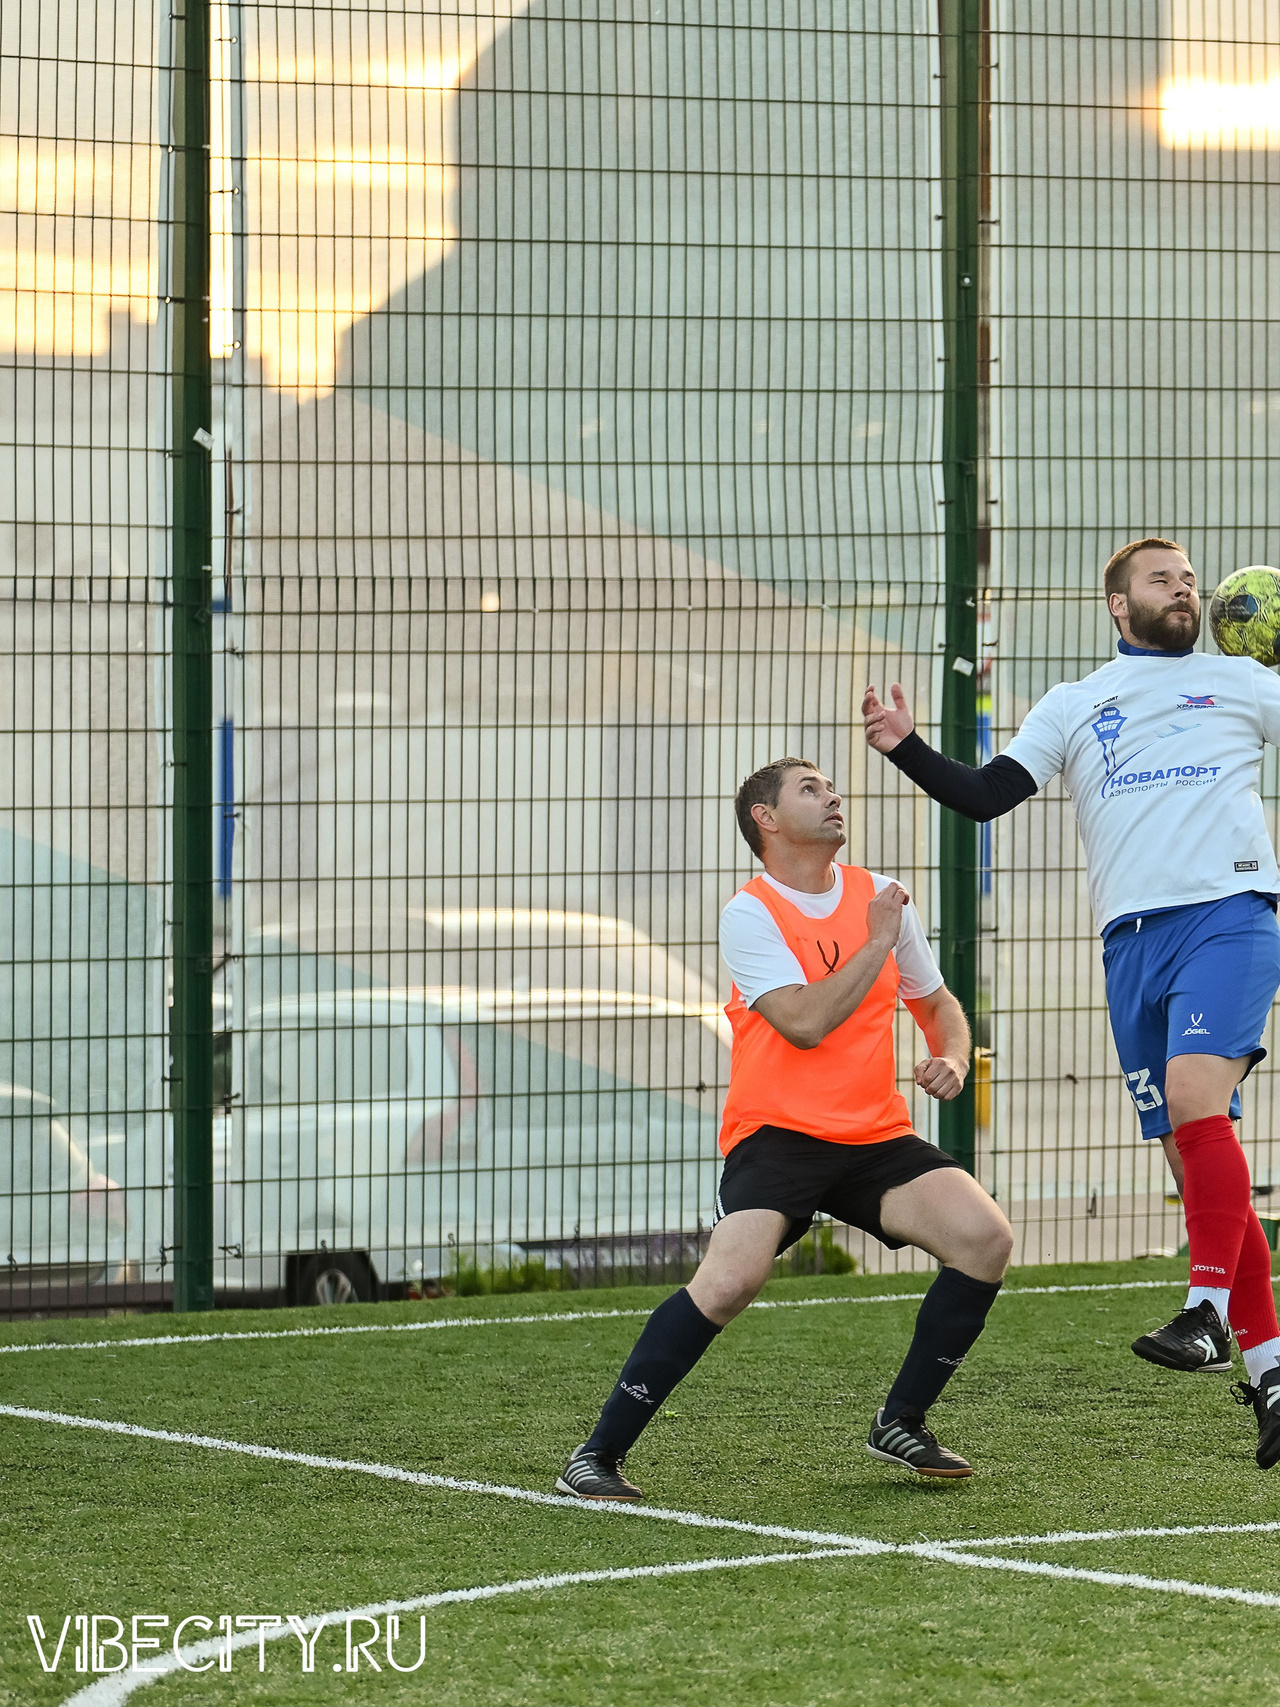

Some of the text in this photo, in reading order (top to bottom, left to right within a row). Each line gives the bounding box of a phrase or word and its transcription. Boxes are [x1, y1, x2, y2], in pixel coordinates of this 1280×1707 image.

[1109, 778, 1216, 798] АЭРОПОРТЫ РОССИИ
[1110, 765, 1221, 789] НОВАПОРТ
[620, 1381, 655, 1405] DEMIX
